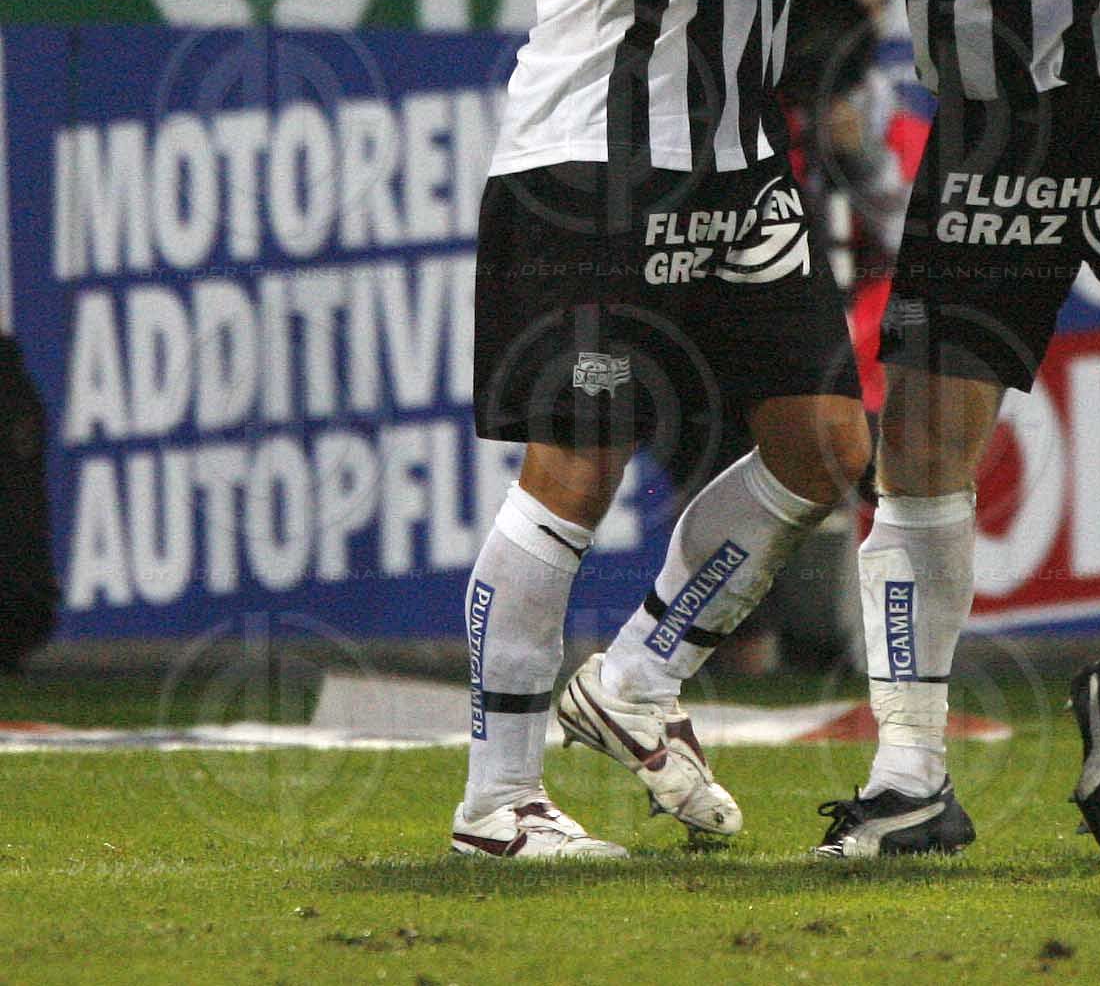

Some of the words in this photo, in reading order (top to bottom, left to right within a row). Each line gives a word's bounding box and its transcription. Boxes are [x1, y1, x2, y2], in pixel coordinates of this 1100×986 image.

[936, 211, 1068, 246] GRAZ
[650, 541, 746, 656] PUNTIGAMER
[469, 585, 493, 736] PUNTIGAMER
